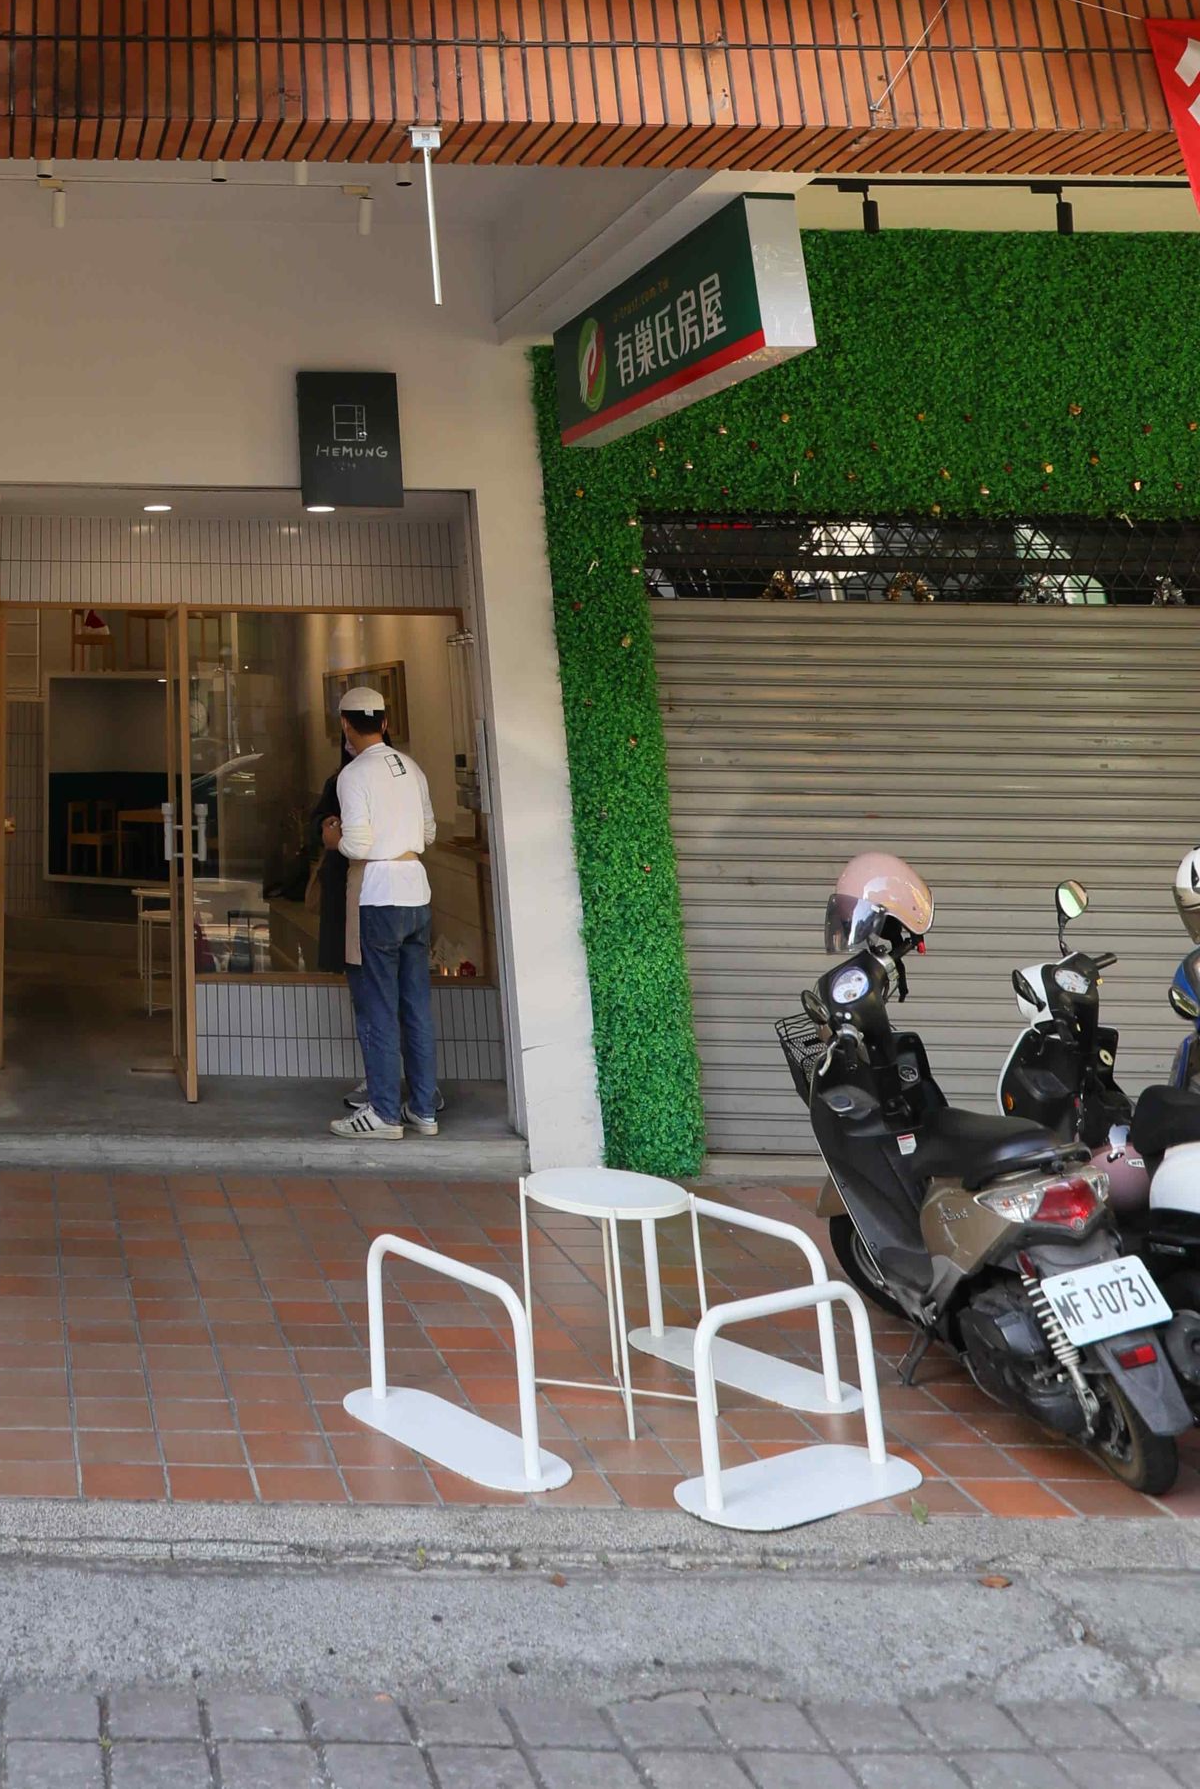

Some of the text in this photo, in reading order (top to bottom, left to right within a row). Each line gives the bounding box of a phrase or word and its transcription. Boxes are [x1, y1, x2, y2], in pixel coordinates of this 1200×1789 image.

[614, 273, 727, 387] 有巢氏房屋
[316, 444, 388, 458] HEMUNG
